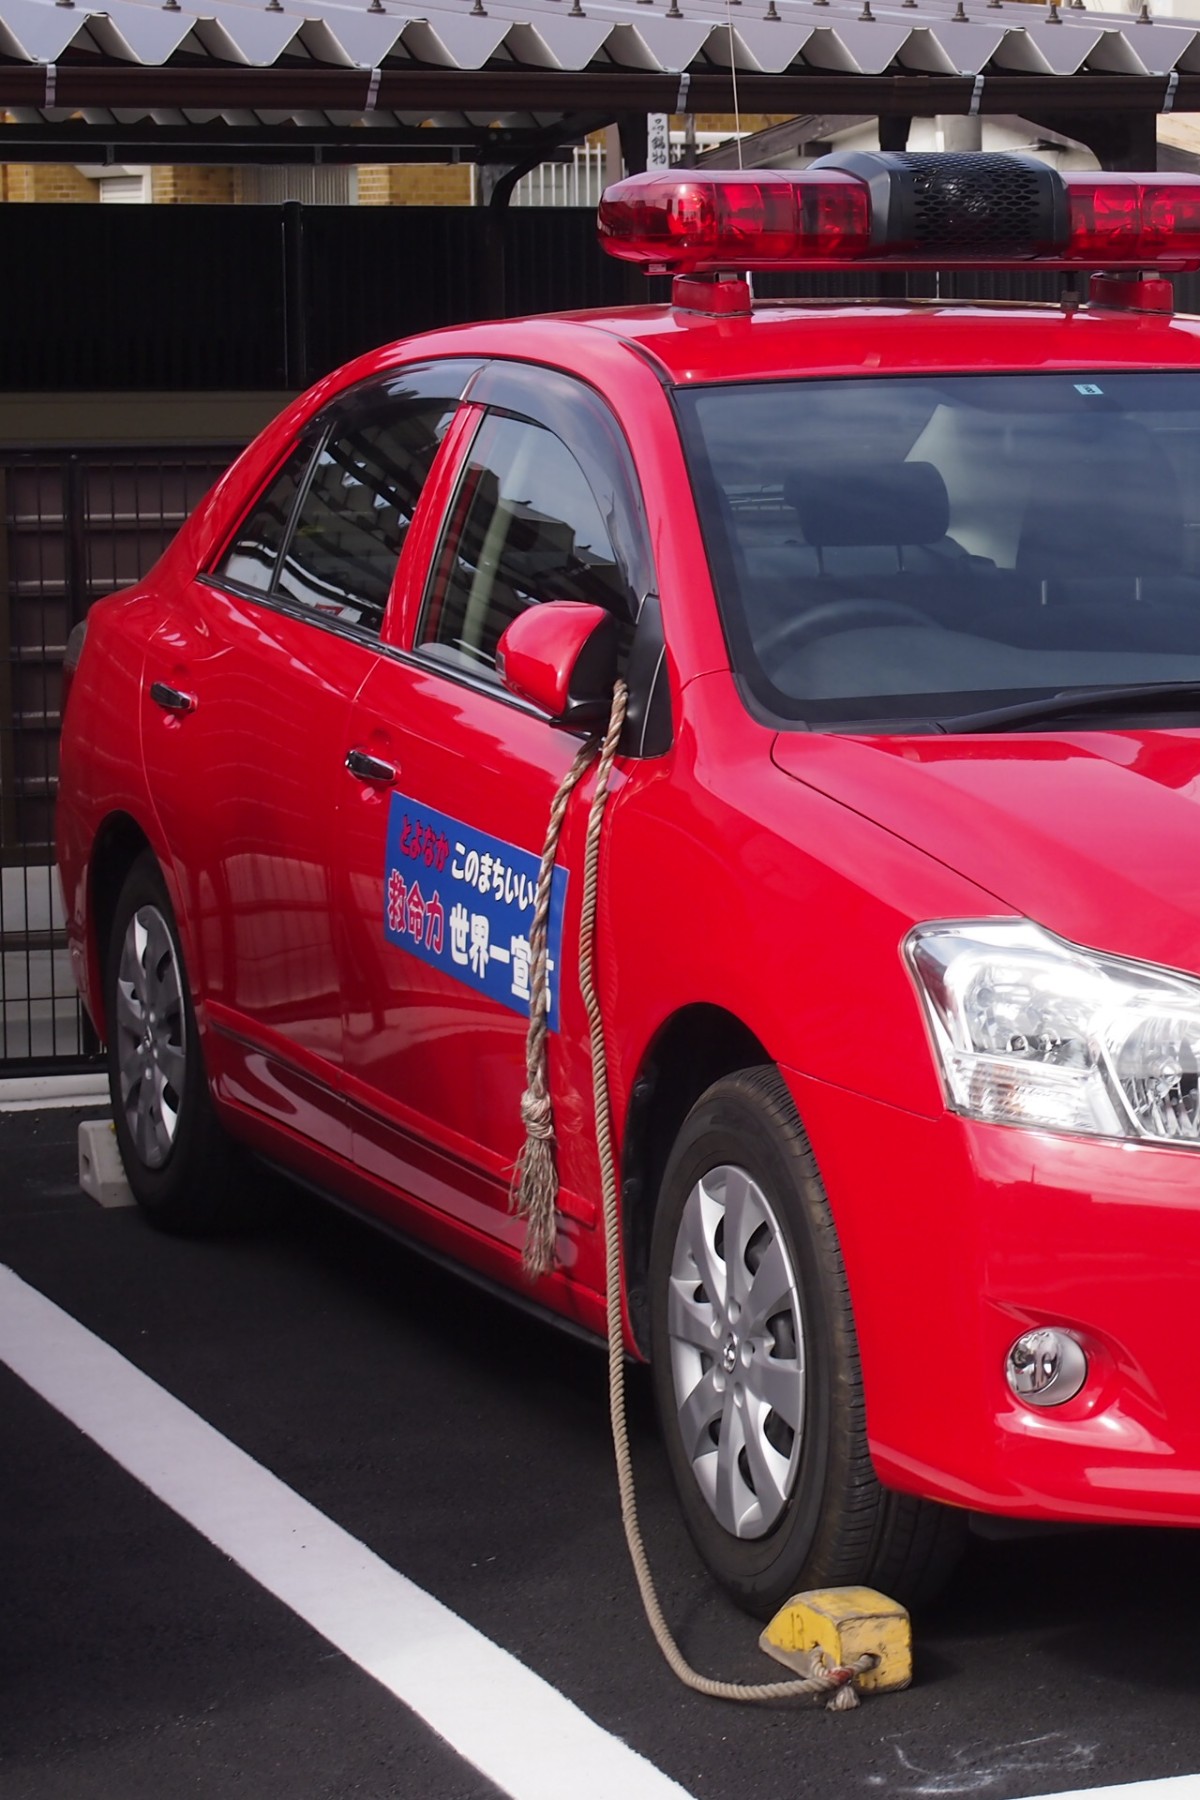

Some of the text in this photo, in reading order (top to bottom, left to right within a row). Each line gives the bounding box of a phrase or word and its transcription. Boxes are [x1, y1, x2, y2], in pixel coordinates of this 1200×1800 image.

[400, 813, 541, 911] とよなか このまちいい
[387, 868, 445, 954] 救命力
